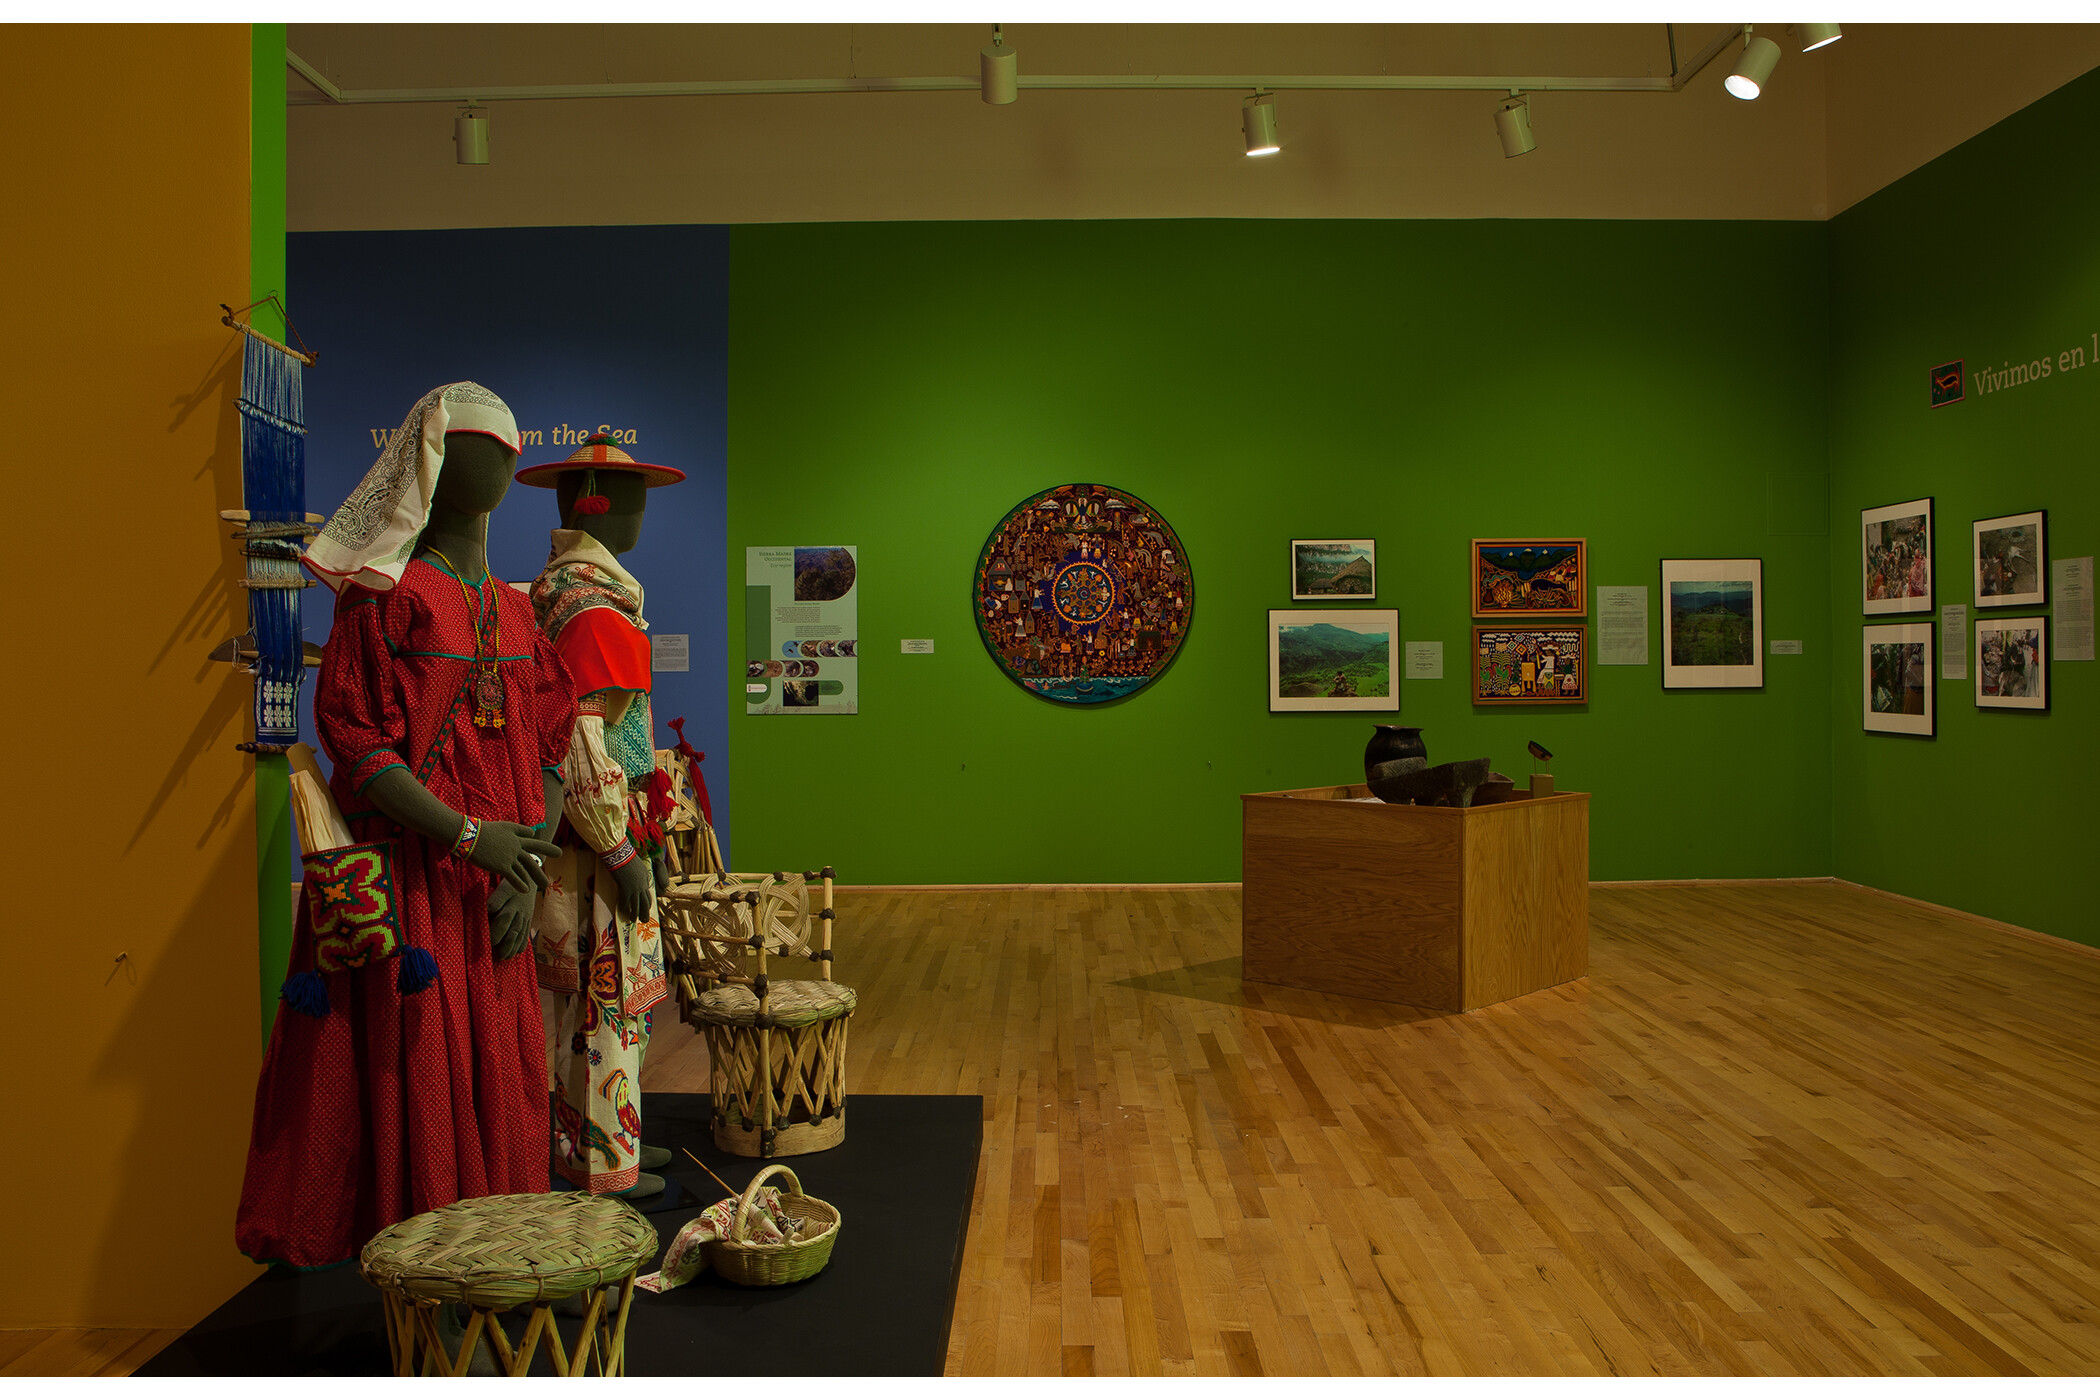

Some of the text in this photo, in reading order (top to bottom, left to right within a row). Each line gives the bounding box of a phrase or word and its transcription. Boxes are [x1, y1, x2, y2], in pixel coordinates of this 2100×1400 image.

[1973, 333, 2100, 396] Vivimos en l
[552, 423, 589, 445] the
